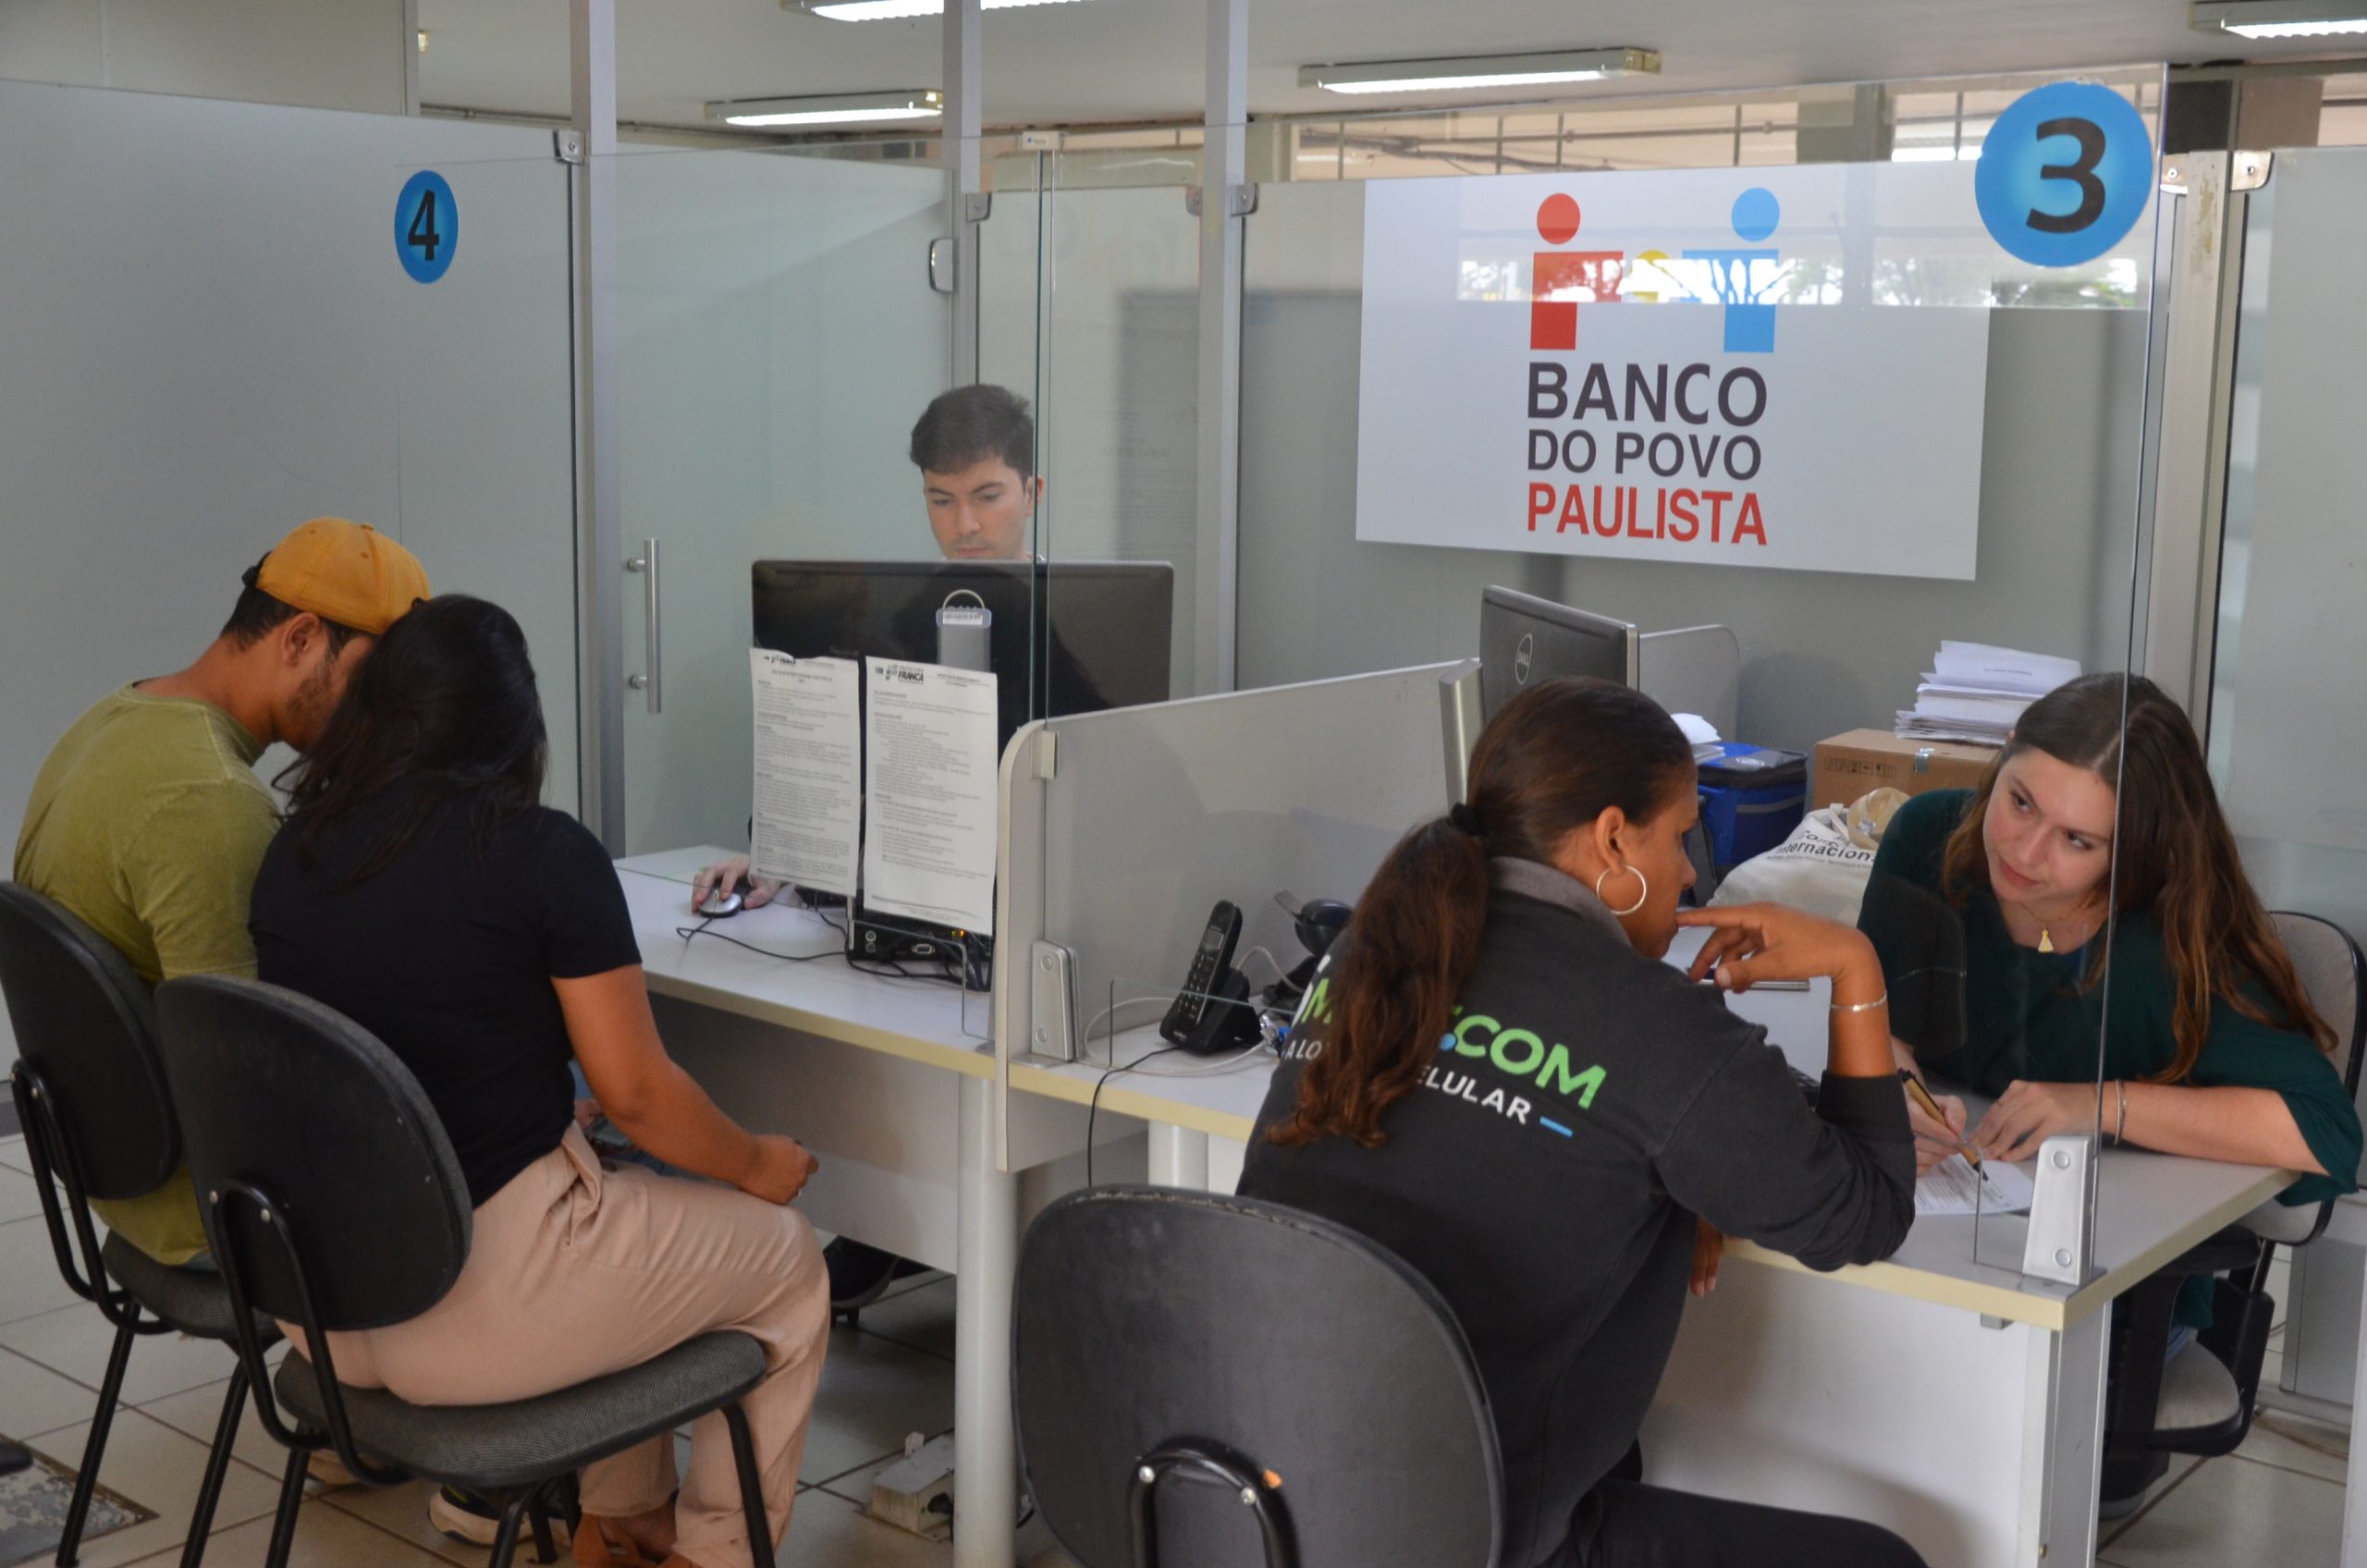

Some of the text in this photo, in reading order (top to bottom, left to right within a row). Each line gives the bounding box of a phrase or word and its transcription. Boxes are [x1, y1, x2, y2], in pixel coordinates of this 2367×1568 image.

[2026, 116, 2106, 235] 3
[408, 190, 439, 261] 4
[1527, 361, 1768, 427] BANCO
[1527, 428, 1762, 481] DO POVO
[1527, 482, 1768, 546] PAULISTA
[1417, 1065, 1532, 1125] LULAR
